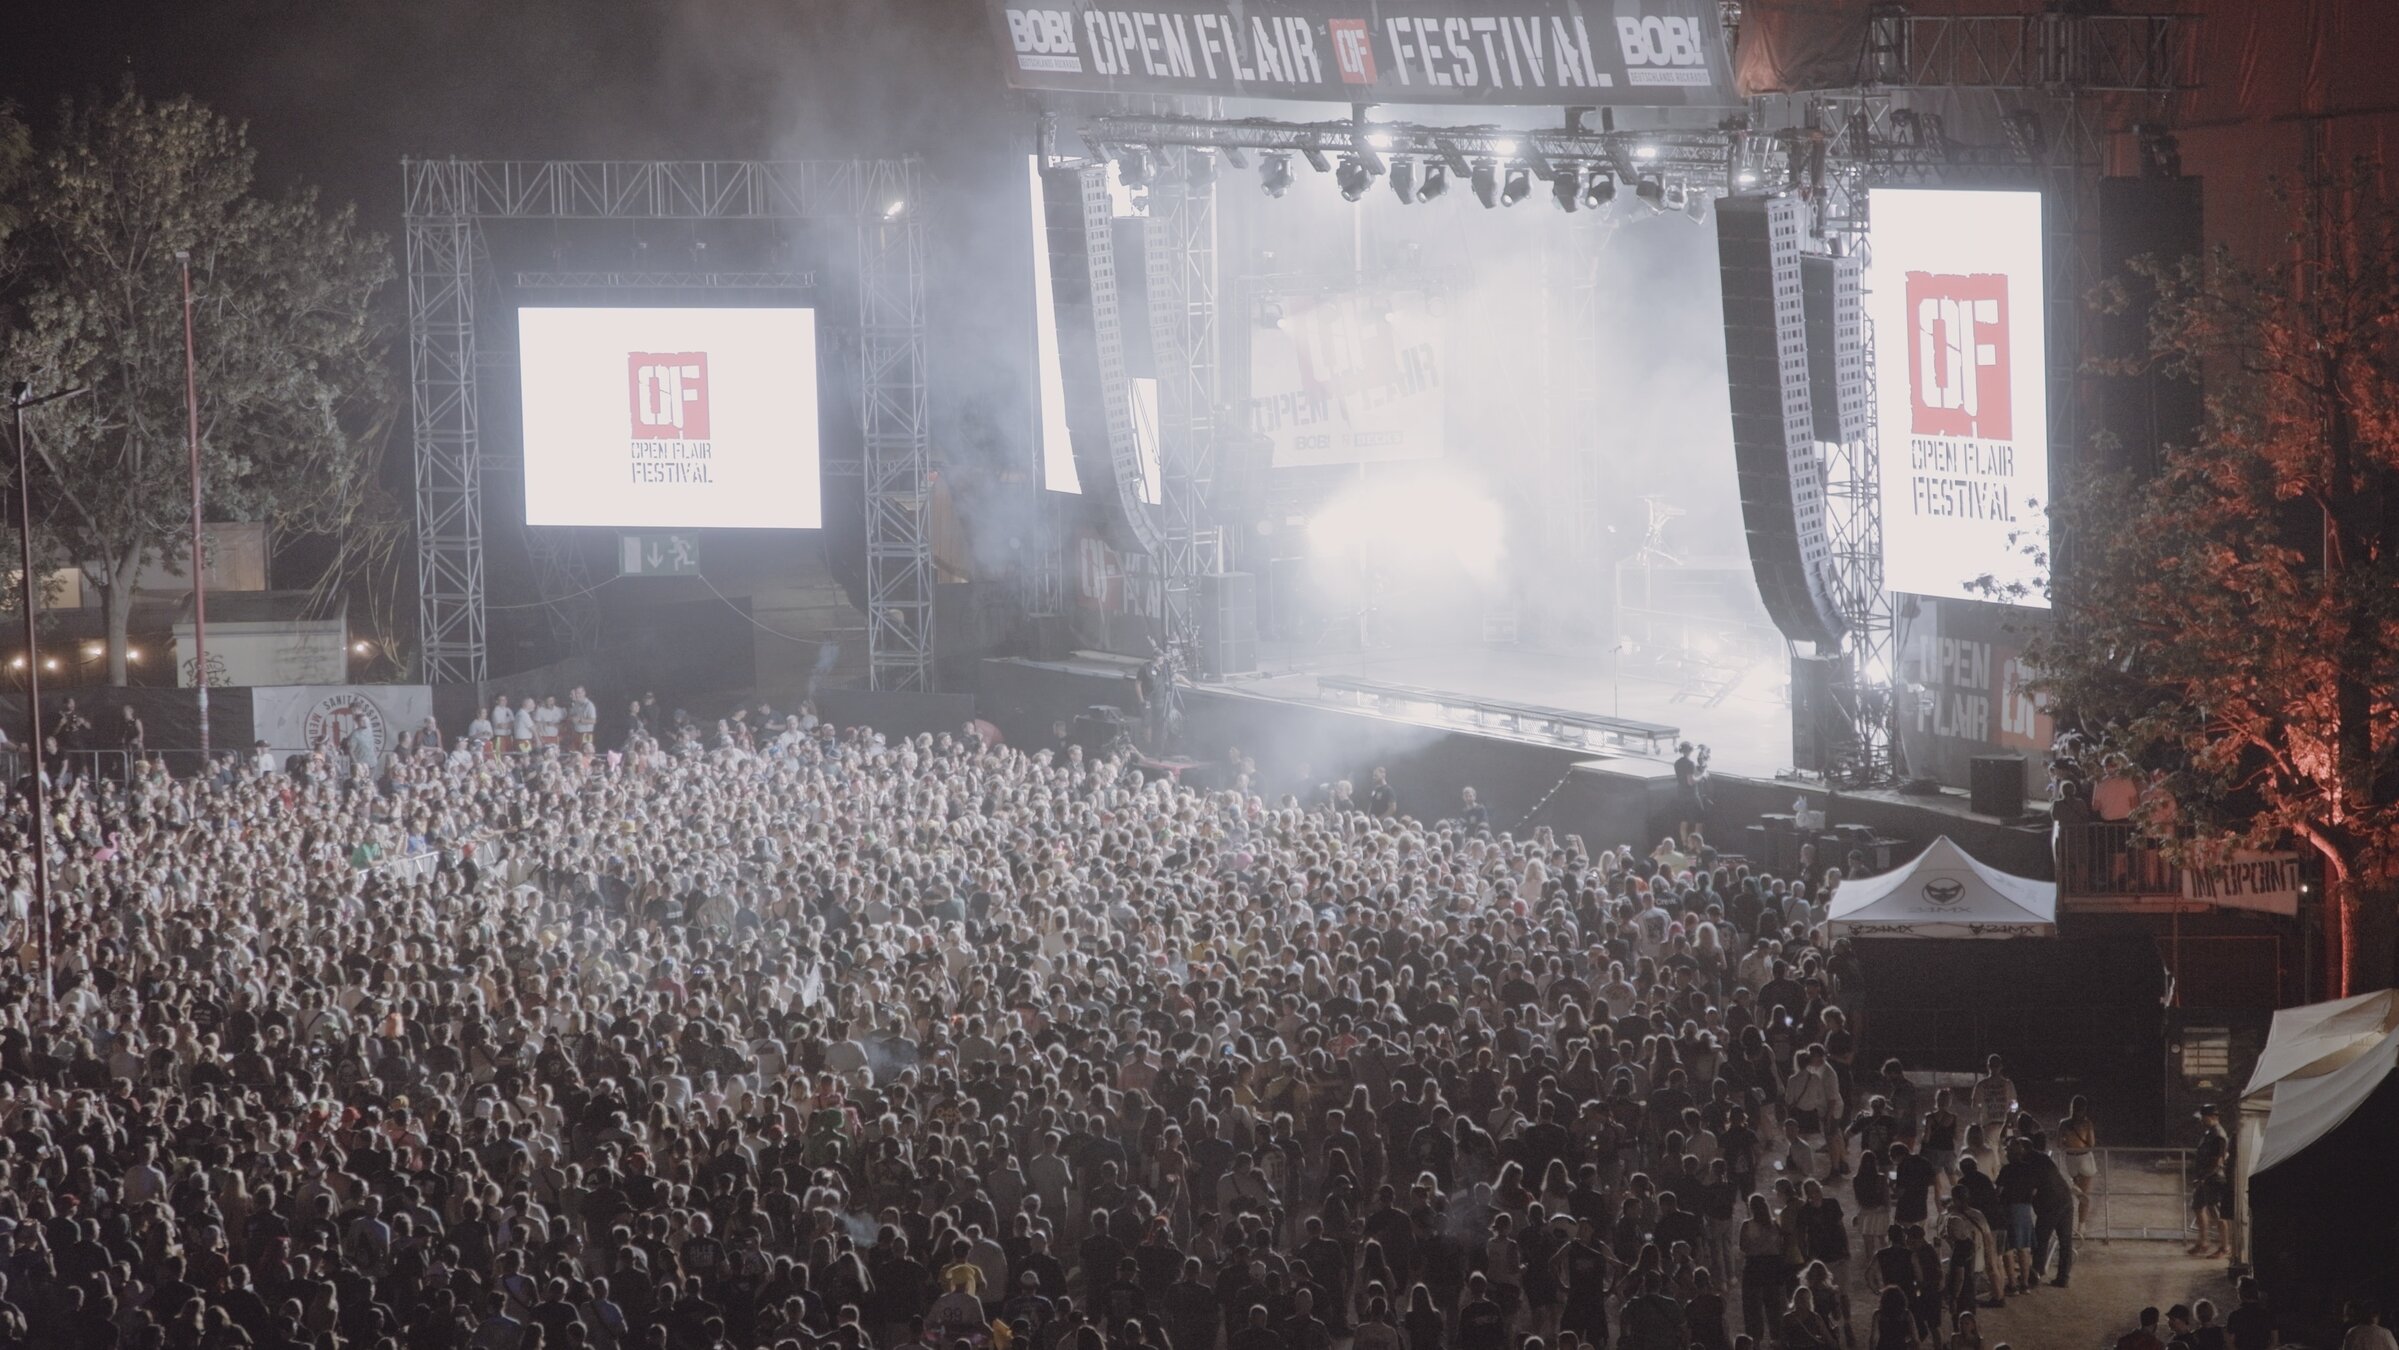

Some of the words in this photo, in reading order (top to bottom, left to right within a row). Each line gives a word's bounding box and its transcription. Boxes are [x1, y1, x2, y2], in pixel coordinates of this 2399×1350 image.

[1006, 9, 1077, 54] BOB!
[1084, 11, 1197, 78] OPEN
[1194, 14, 1322, 83] FLAIR
[1336, 29, 1369, 80] OF
[1385, 16, 1614, 88] FESTIVAL
[1616, 16, 1704, 65] BOB!
[1918, 295, 1999, 416] OF
[638, 364, 700, 429] OF
[631, 442, 667, 459] OPEN
[673, 442, 711, 459] FLAIR
[632, 462, 713, 483] FESTIVAL
[1911, 440, 1957, 473] OPEN
[1965, 443, 2014, 477] FLAIR
[1912, 476, 2016, 522] FESTIVAL
[1081, 539, 1116, 602] OF
[1919, 634, 1991, 690] OPEN
[1917, 689, 1990, 742] FLAIR
[1865, 924, 1914, 934] 24MX
[1906, 906, 1973, 914] 24MX
[1985, 924, 2036, 935] 24MX
